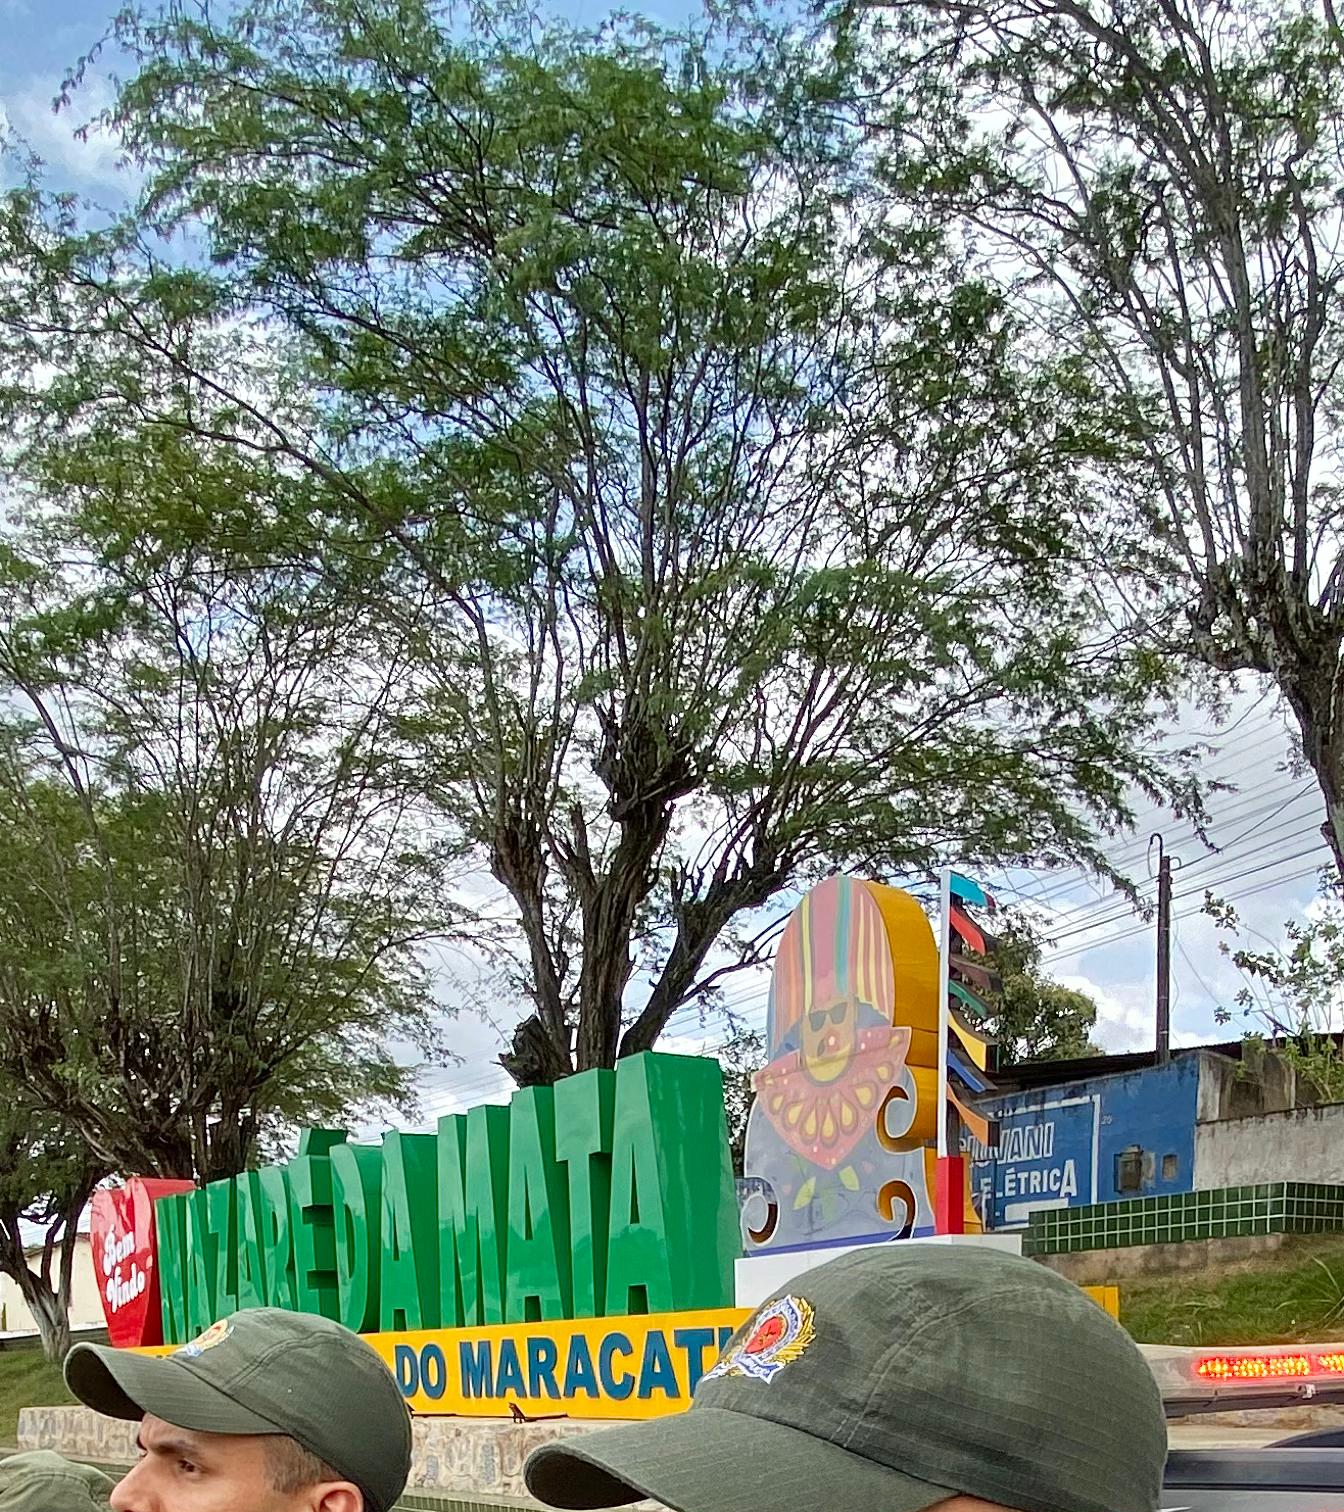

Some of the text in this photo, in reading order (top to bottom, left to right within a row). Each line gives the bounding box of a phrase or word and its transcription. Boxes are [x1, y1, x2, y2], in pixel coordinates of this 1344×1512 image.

[330, 1130, 426, 1333] DA
[437, 1051, 678, 1327] MATA
[394, 1342, 446, 1398] DO
